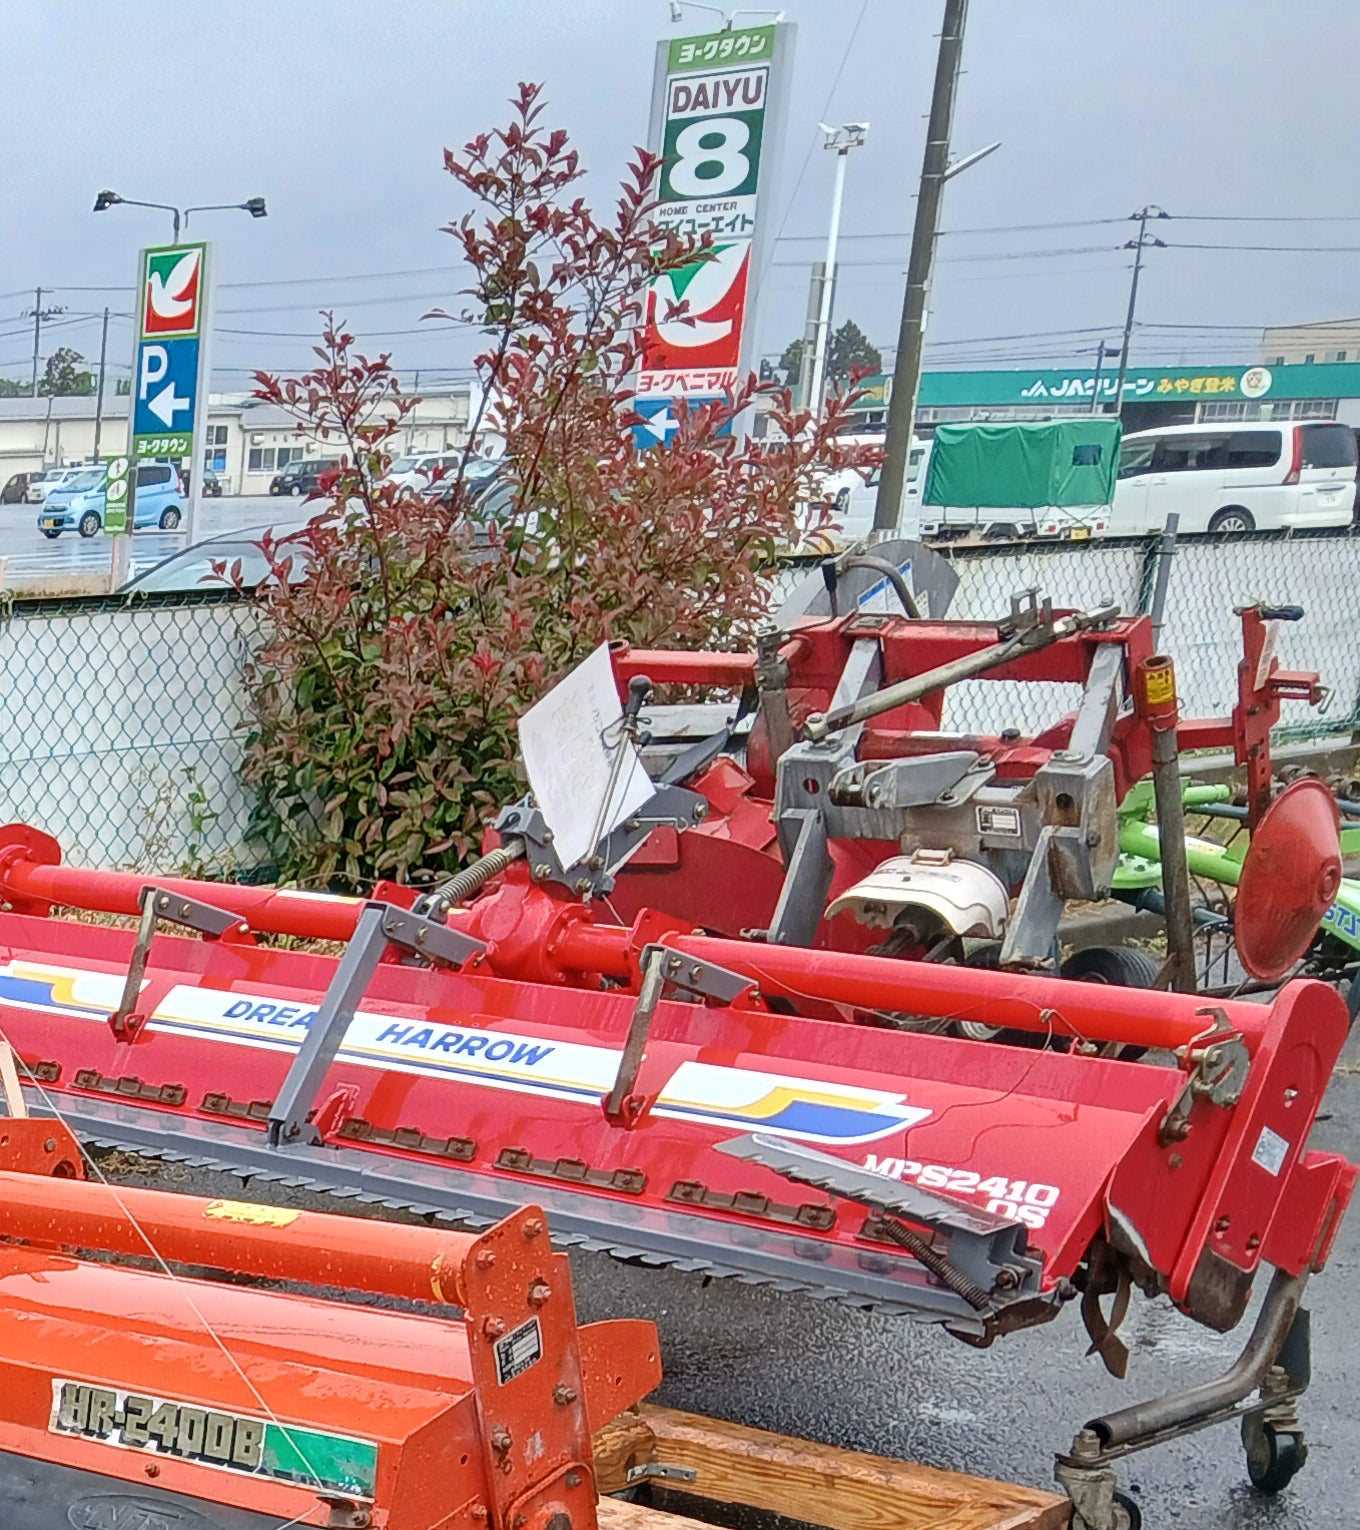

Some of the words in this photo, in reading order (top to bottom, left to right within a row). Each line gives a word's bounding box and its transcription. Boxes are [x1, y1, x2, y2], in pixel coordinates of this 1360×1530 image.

[678, 34, 766, 63] ヨークタウン
[672, 75, 763, 114] DAIYU
[669, 117, 750, 197] 8
[659, 204, 688, 216] HOME
[695, 201, 738, 214] CENTER
[139, 345, 168, 400] P
[637, 371, 737, 393] ヨークベニマル
[1157, 376, 1237, 394] みやぎ登米
[137, 438, 188, 454] ヨークタウン
[222, 1000, 322, 1032] DREA
[376, 1023, 556, 1066] HARROW
[863, 1153, 1060, 1207] MPS2410
[61, 1384, 265, 1468] HR-2400B
